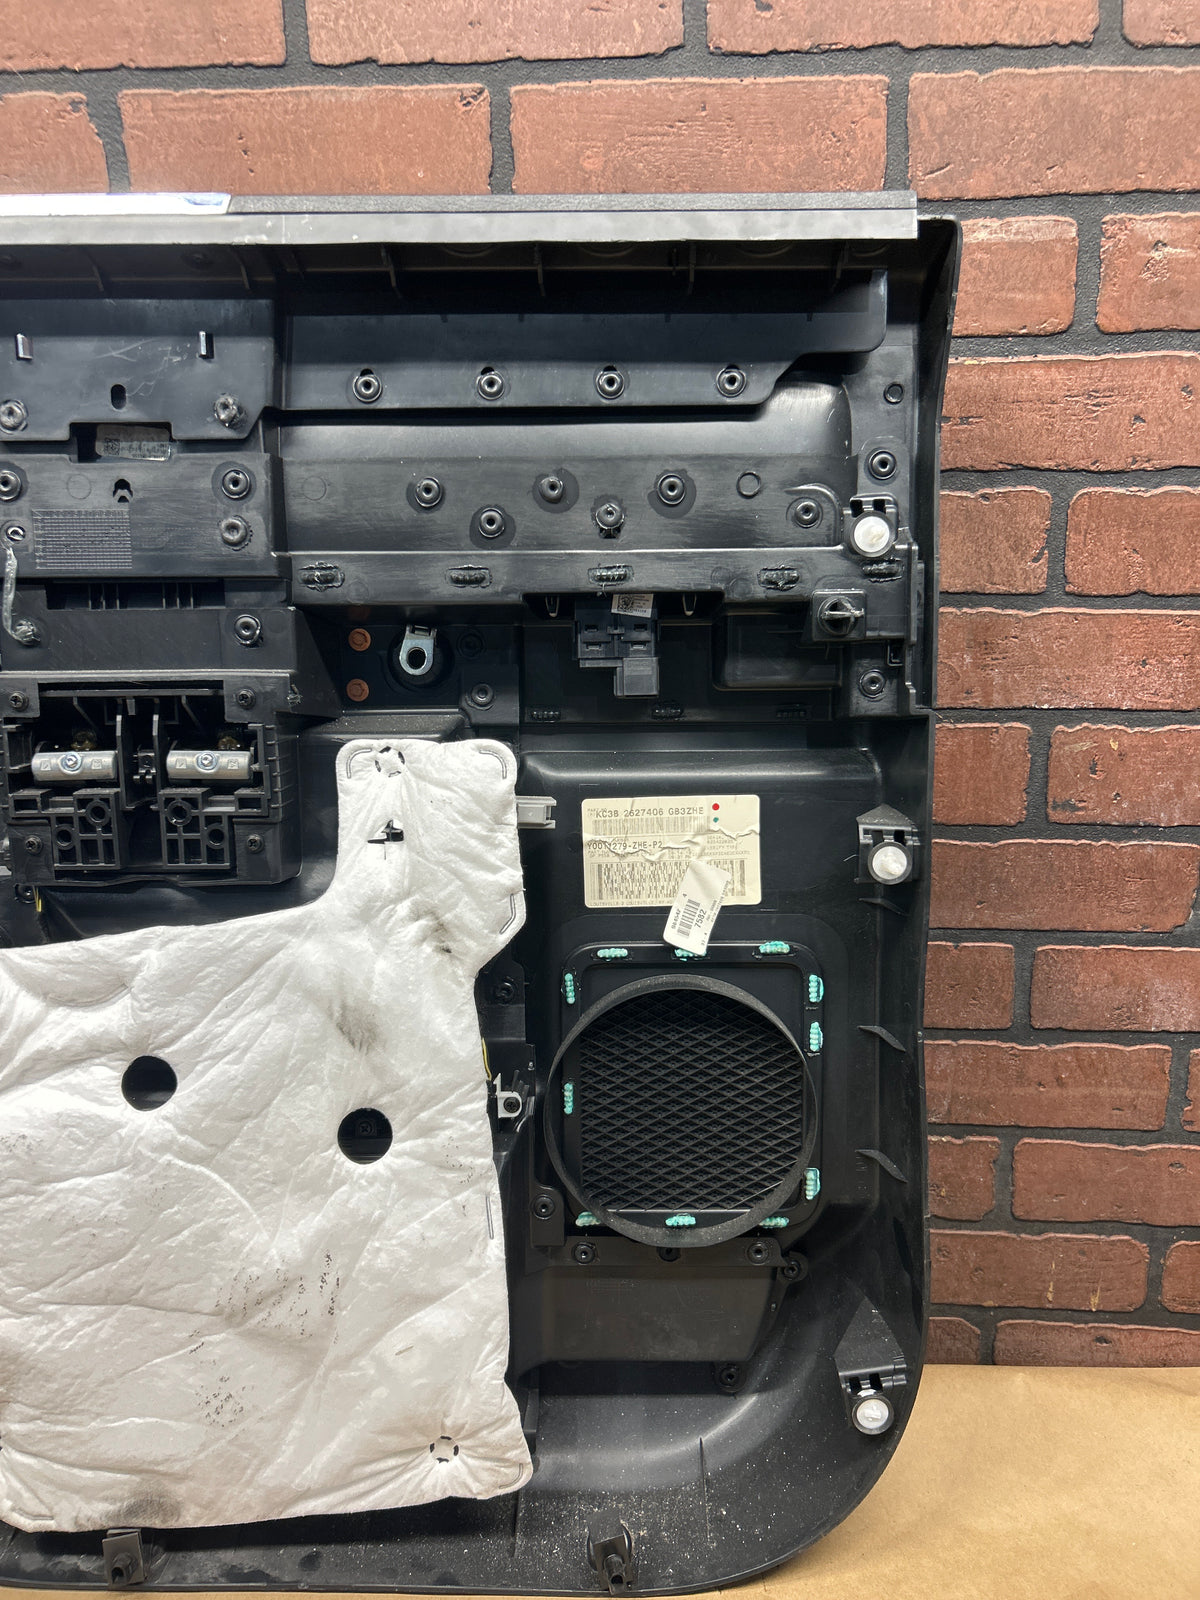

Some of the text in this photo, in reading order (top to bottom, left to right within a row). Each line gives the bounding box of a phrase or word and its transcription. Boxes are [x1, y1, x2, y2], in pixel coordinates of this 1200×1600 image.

[623, 808, 664, 818] 2627406
[668, 806, 704, 816] GB3ZHE
[694, 908, 707, 928] 7582
